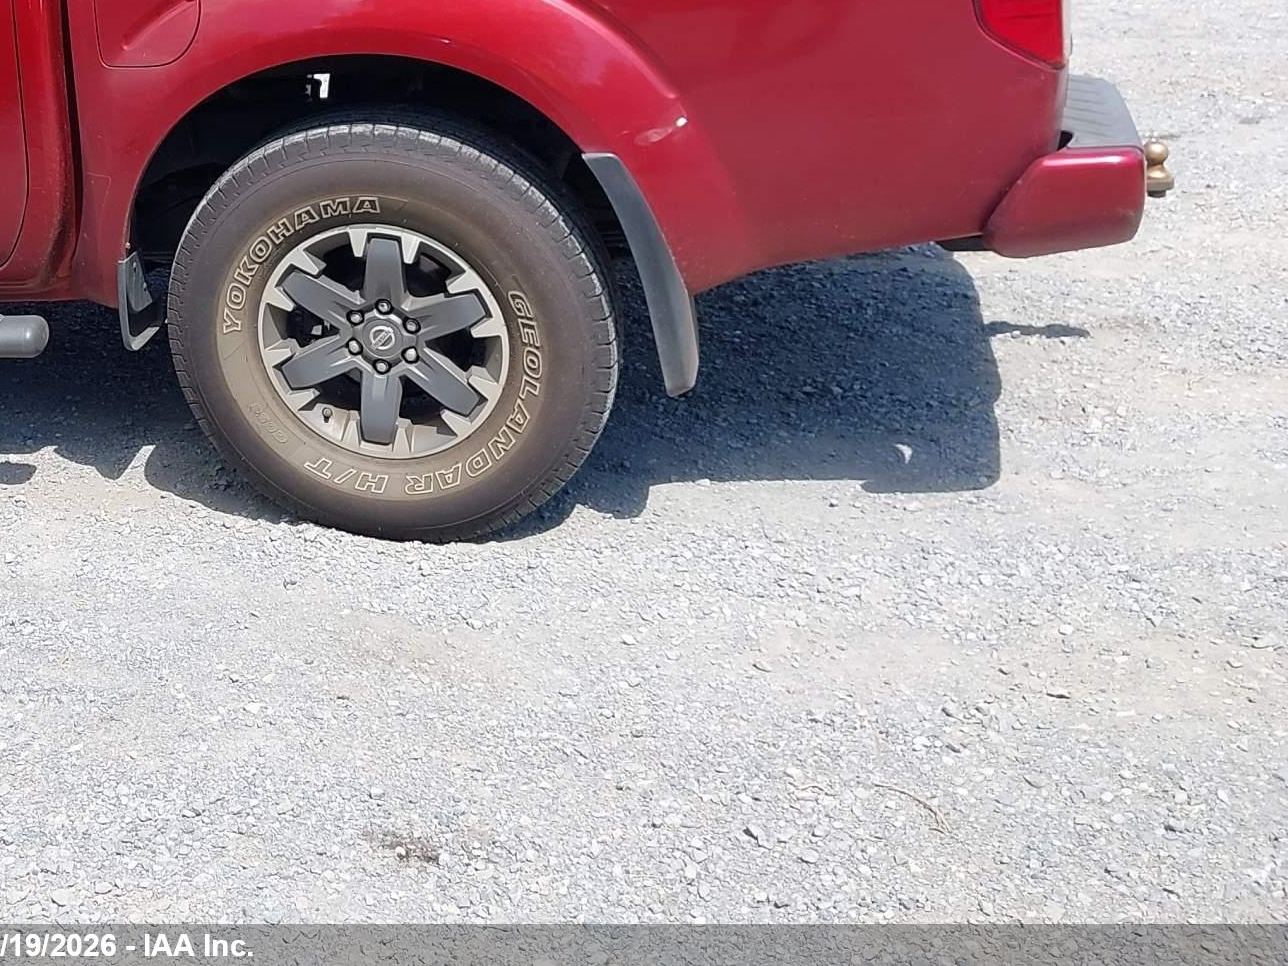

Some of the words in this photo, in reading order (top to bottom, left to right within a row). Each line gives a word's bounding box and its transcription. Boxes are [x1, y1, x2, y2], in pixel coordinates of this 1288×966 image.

[223, 196, 380, 334] YOKOHAMA
[404, 290, 543, 495] GEOLANDAR
[303, 456, 390, 495] H/T
